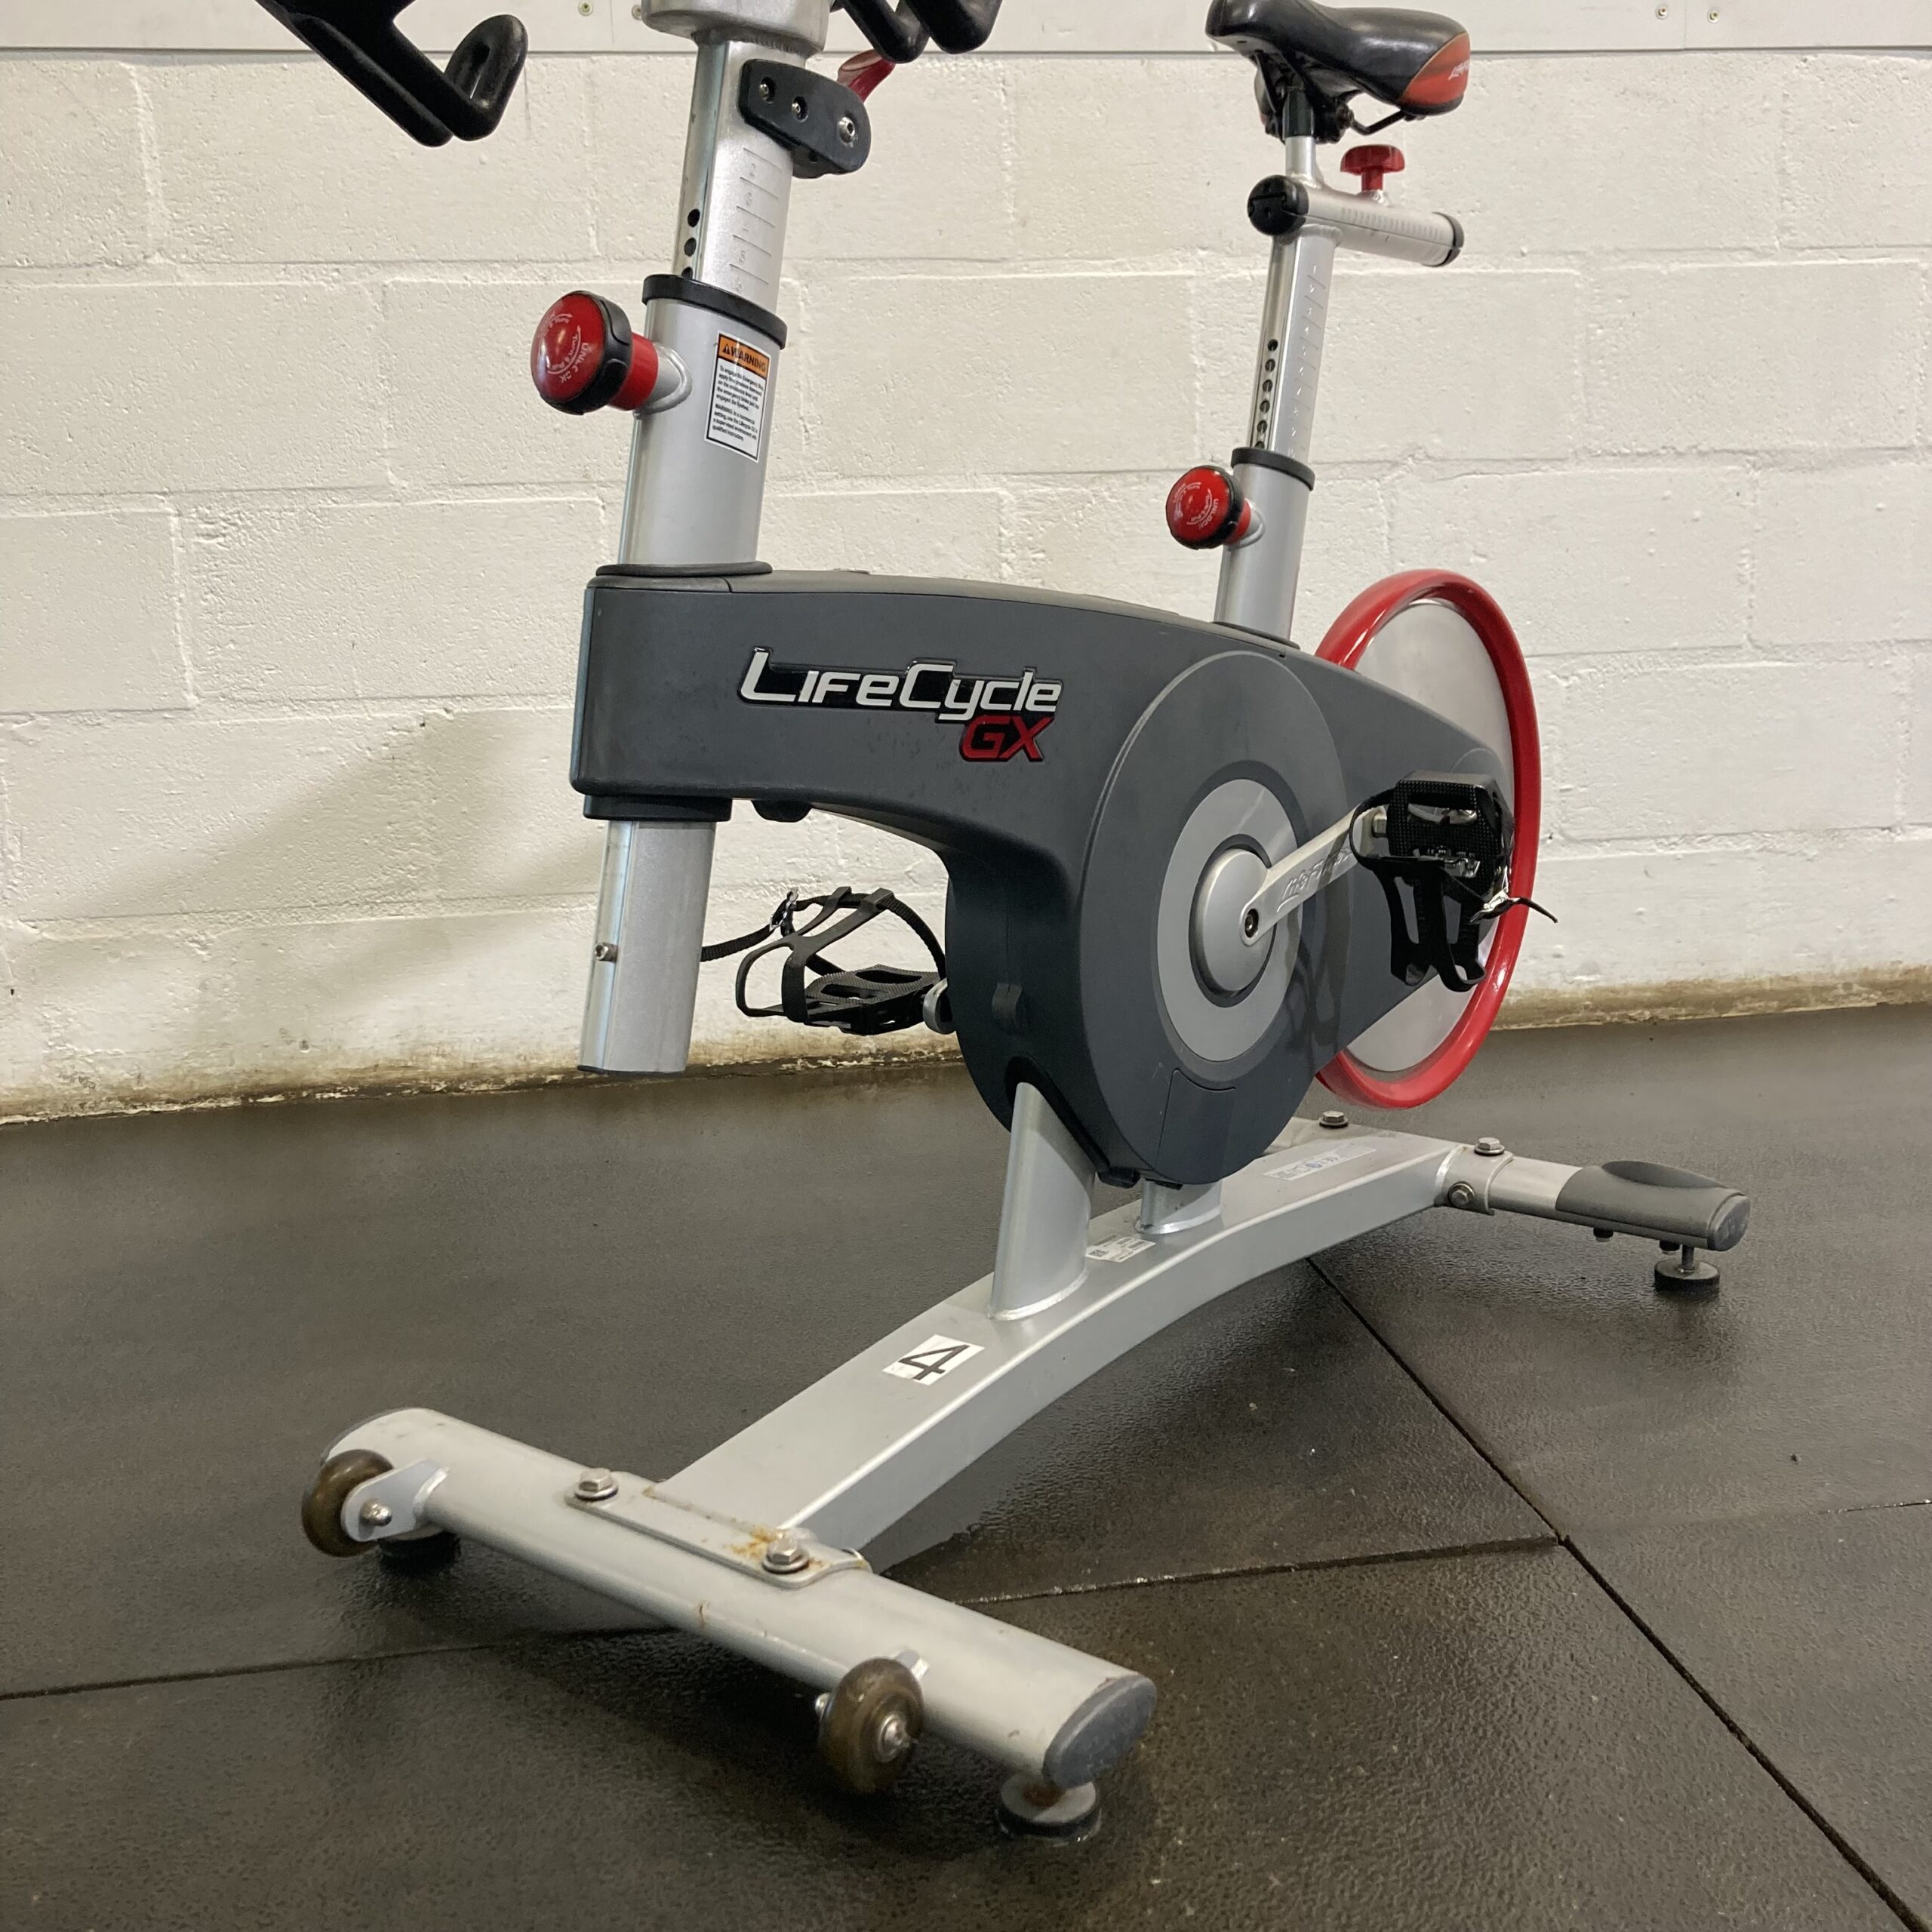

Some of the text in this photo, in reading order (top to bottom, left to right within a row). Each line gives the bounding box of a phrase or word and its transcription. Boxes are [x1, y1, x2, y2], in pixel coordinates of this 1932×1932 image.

[731, 346, 766, 372] WARNING
[962, 715, 1055, 760] GX
[898, 1343, 971, 1381] 4
